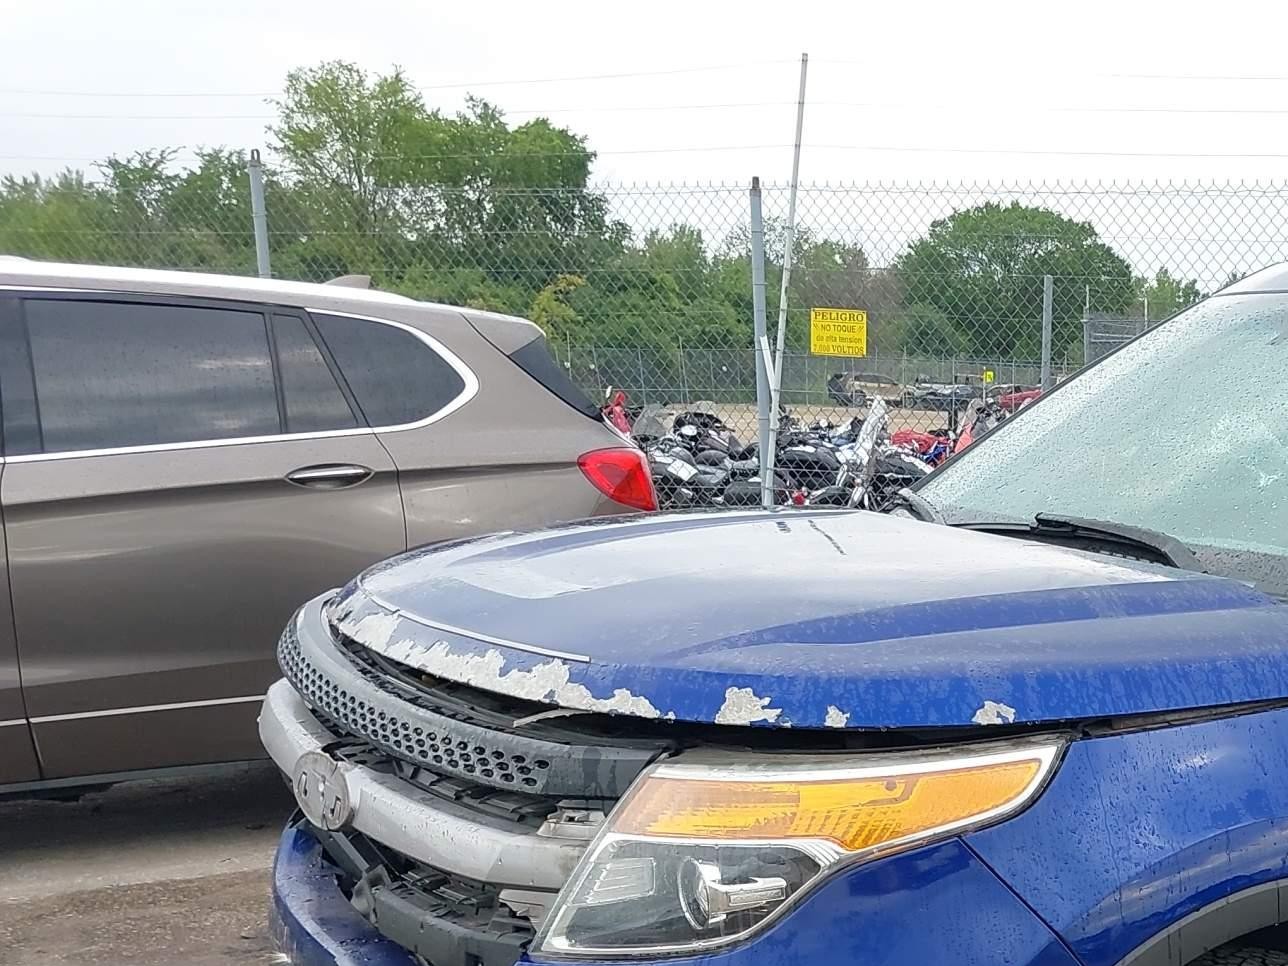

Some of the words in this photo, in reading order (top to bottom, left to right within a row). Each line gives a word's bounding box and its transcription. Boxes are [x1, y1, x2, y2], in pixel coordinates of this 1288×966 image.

[815, 312, 864, 322] PELIGRO
[821, 324, 831, 332] NO
[832, 324, 857, 333] TOQUE
[832, 344, 864, 355] VOLTIOS
